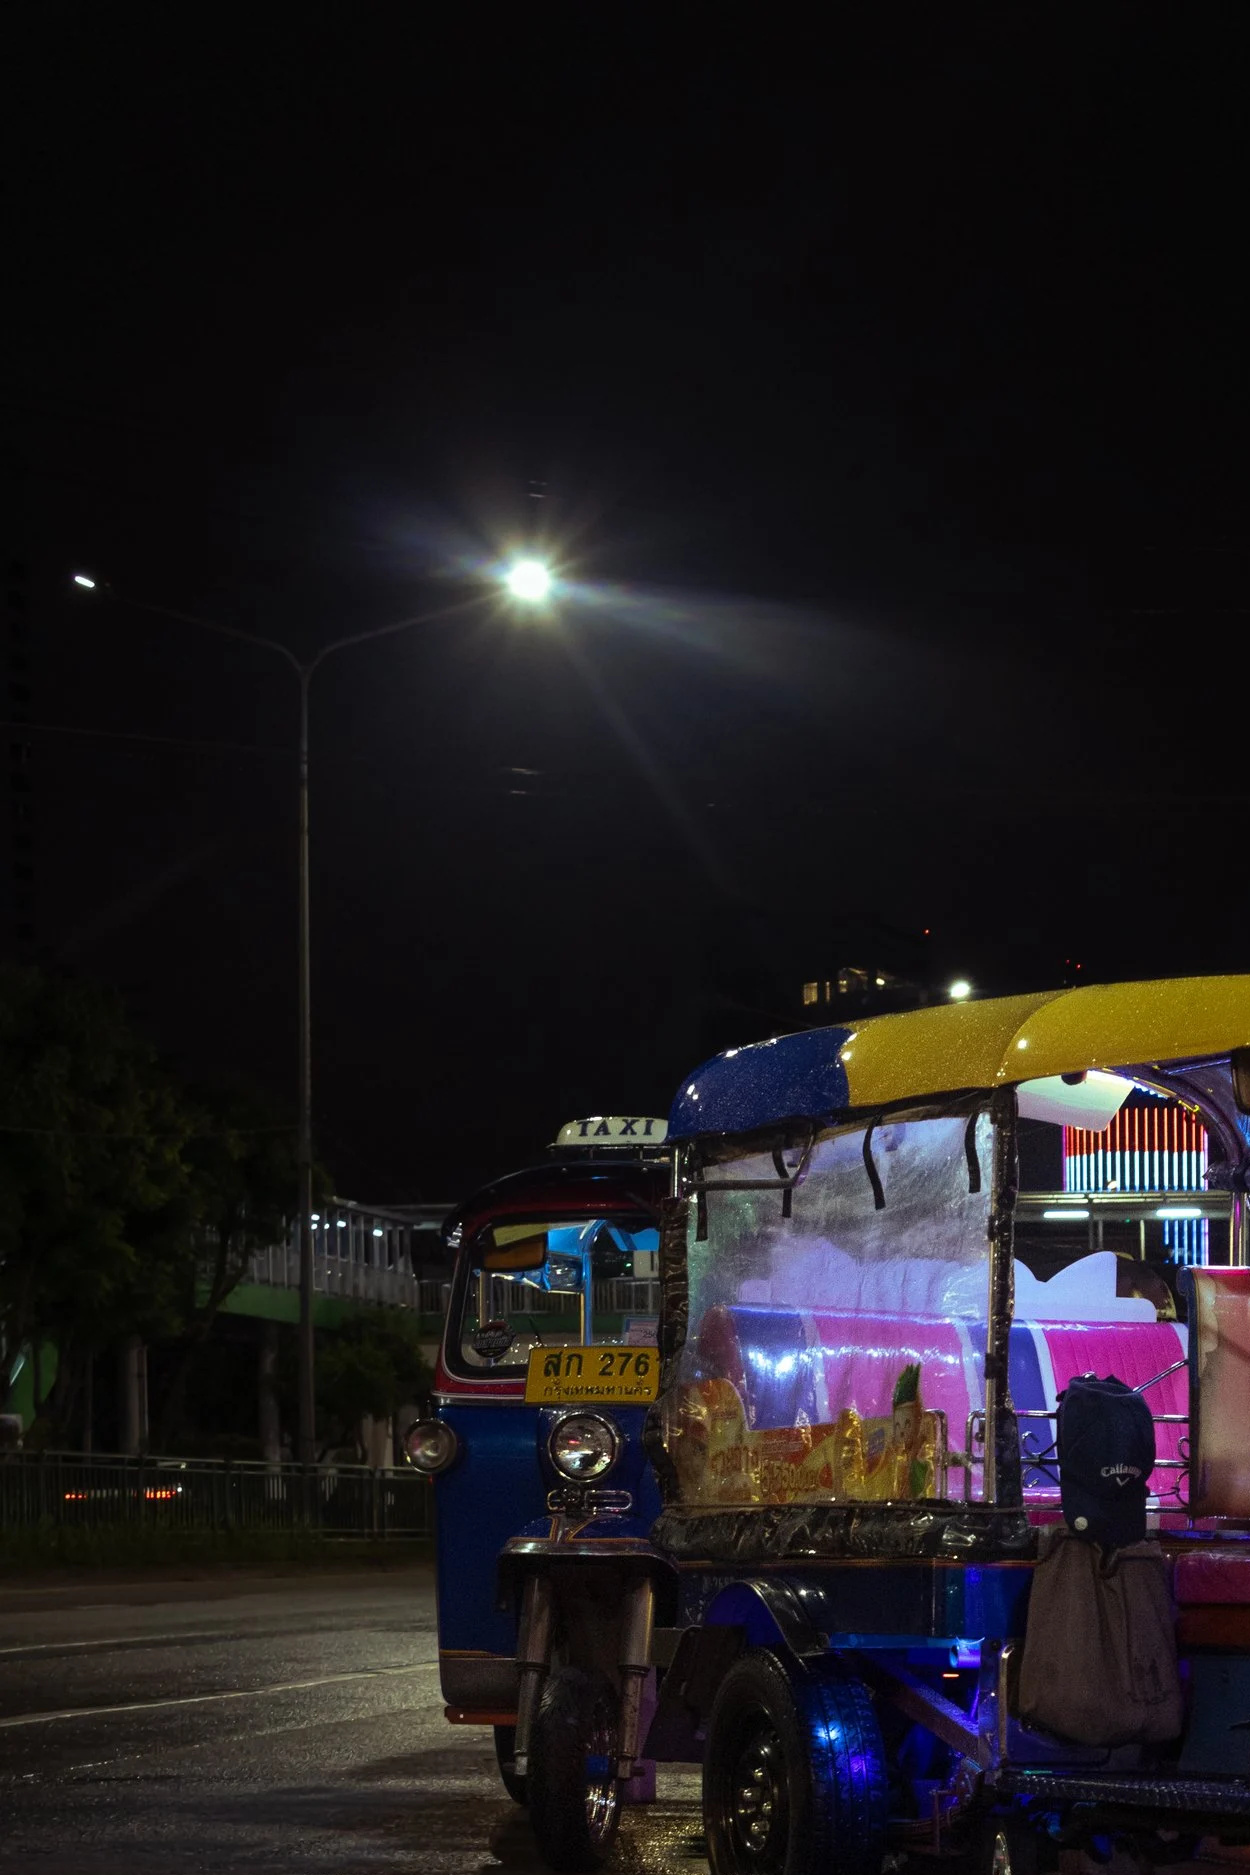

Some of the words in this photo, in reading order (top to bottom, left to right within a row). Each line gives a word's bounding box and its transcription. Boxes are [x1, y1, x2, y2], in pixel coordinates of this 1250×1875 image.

[577, 1119, 655, 1137] TAXI
[543, 1350, 583, 1377] สก
[598, 1352, 650, 1377] 276
